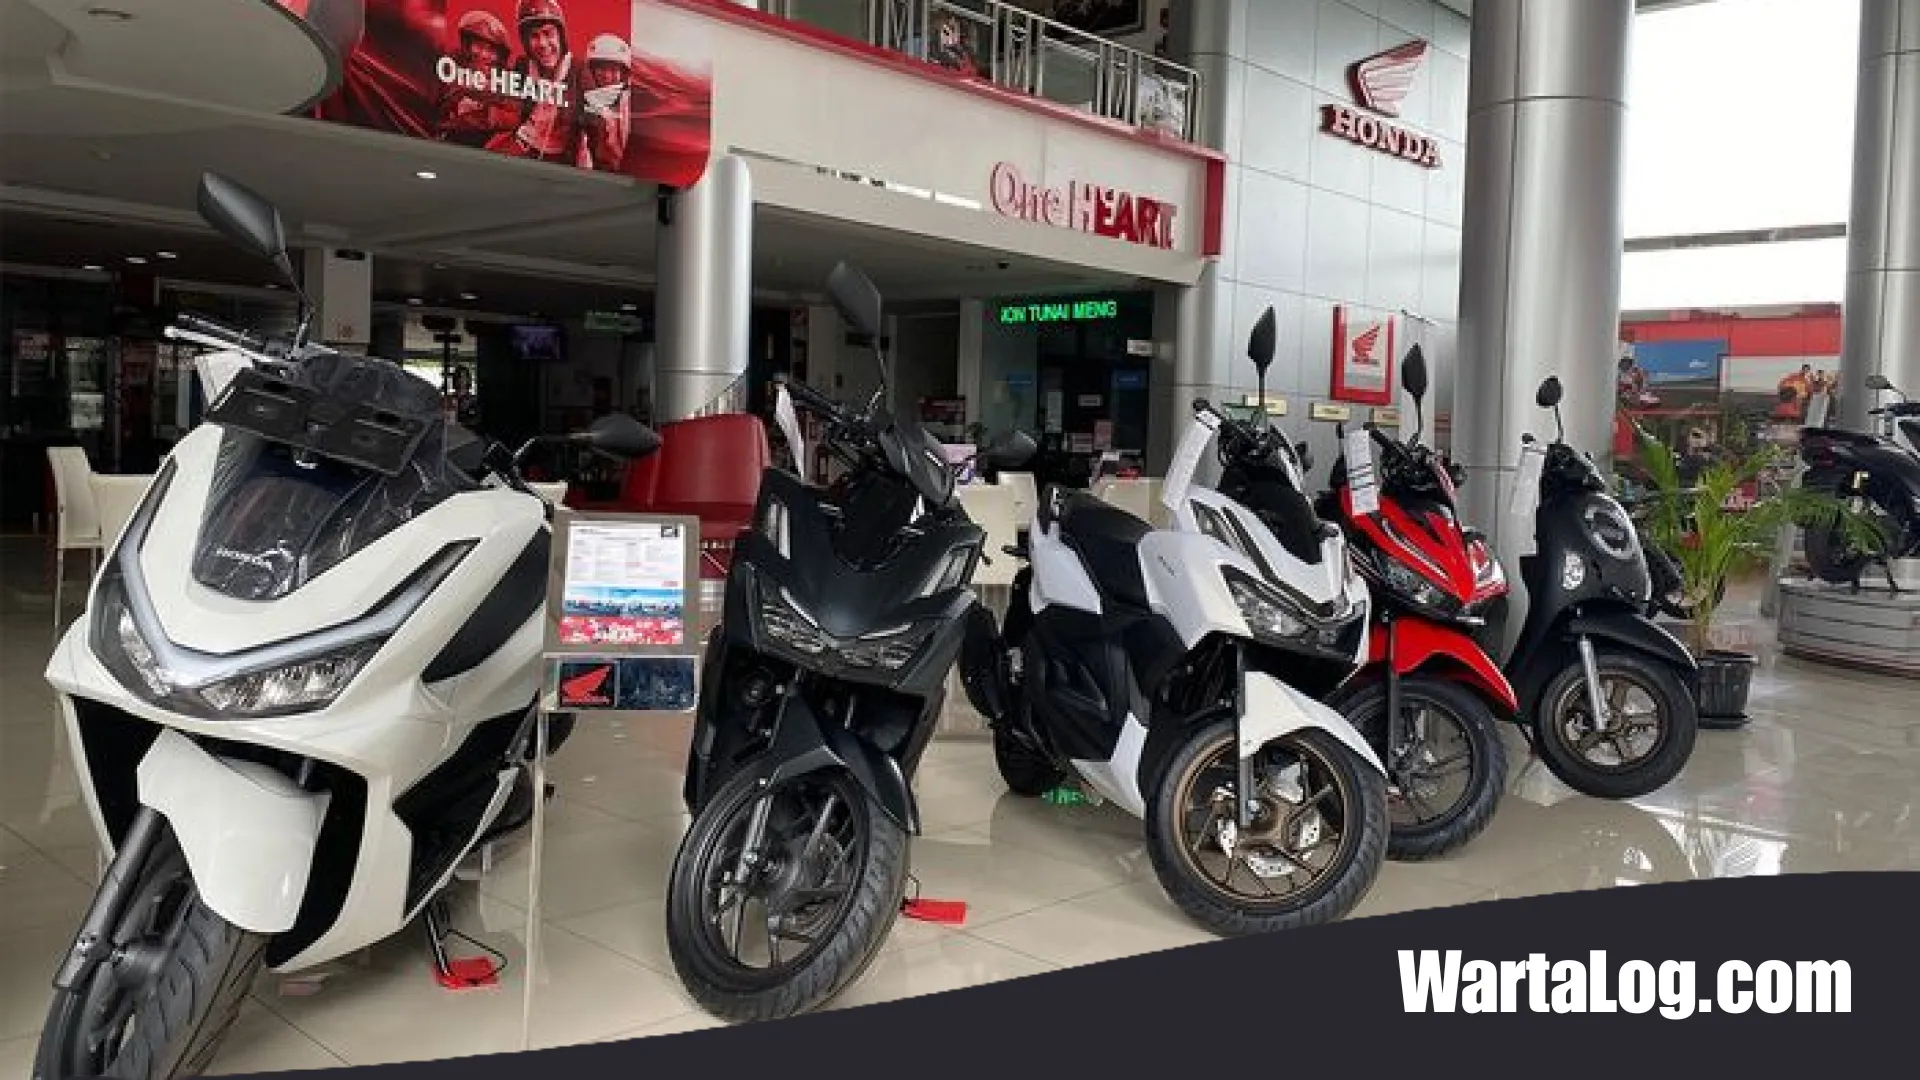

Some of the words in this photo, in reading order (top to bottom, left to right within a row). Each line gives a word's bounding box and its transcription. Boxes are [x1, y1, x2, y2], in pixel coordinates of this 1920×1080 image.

[436, 56, 486, 91] One
[1320, 104, 1441, 168] HONDA
[989, 161, 1063, 227] One
[1029, 304, 1070, 321] TUNAI
